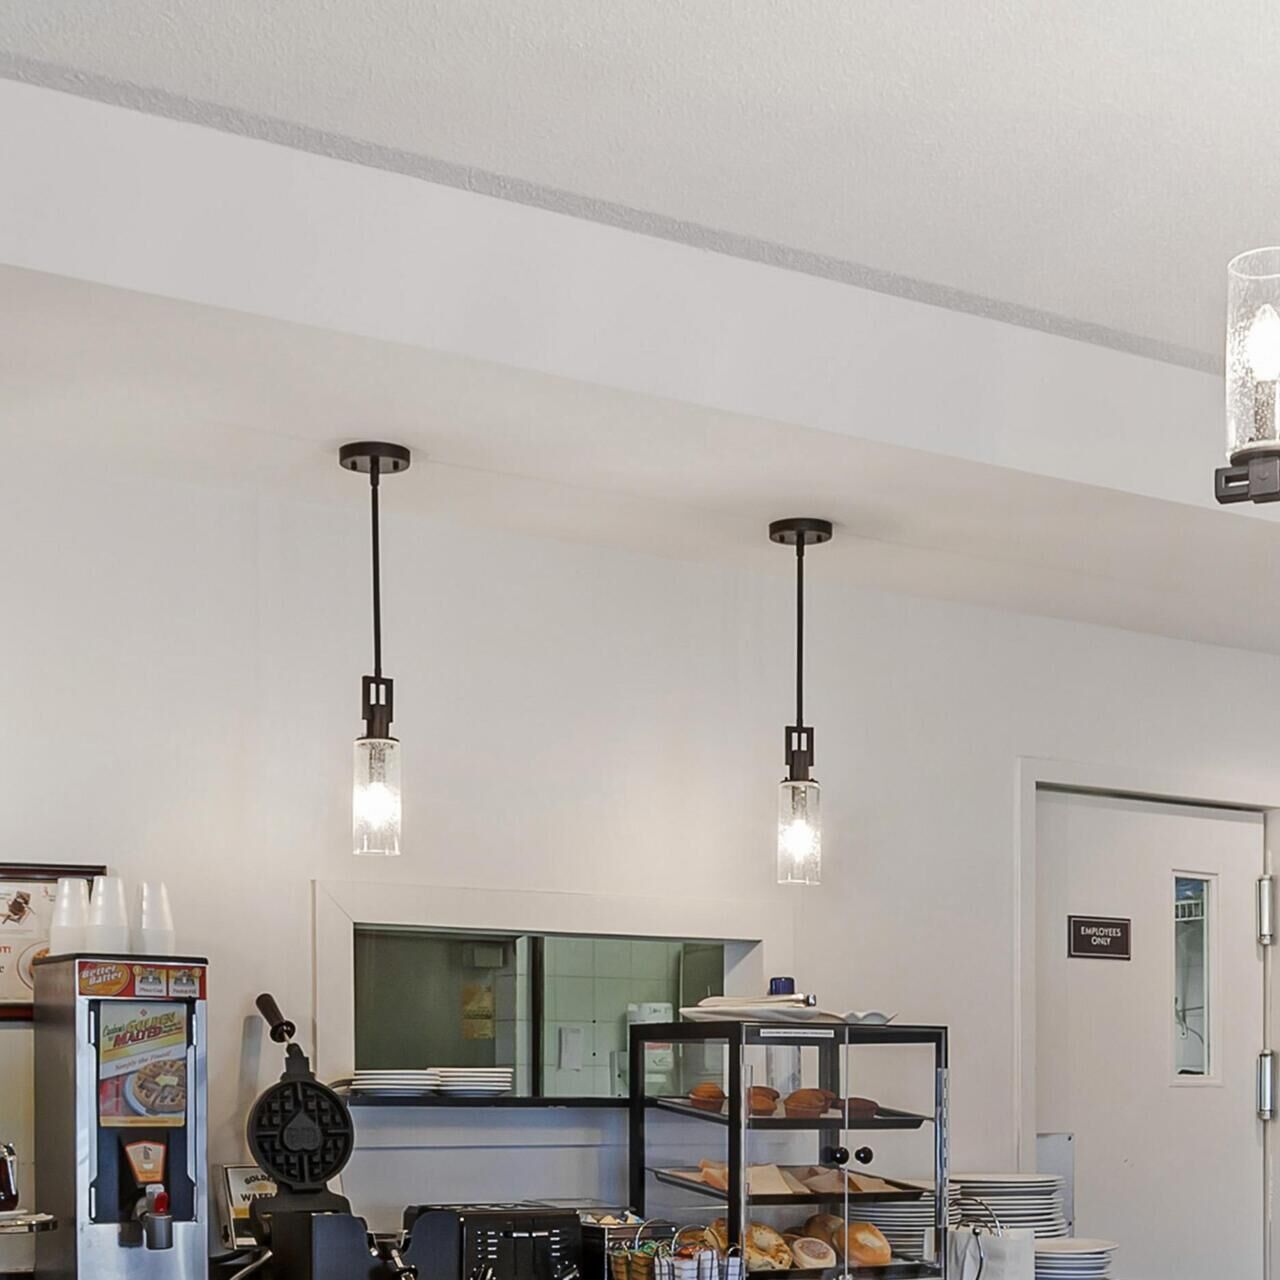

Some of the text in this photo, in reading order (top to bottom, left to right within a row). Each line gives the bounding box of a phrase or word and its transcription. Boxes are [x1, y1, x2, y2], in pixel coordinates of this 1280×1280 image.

[1080, 926, 1122, 937] EMPLOYEES
[1091, 936, 1111, 945] ONLY
[81, 964, 117, 979] Better
[89, 972, 123, 985] Batter
[113, 1026, 163, 1048] MALTED
